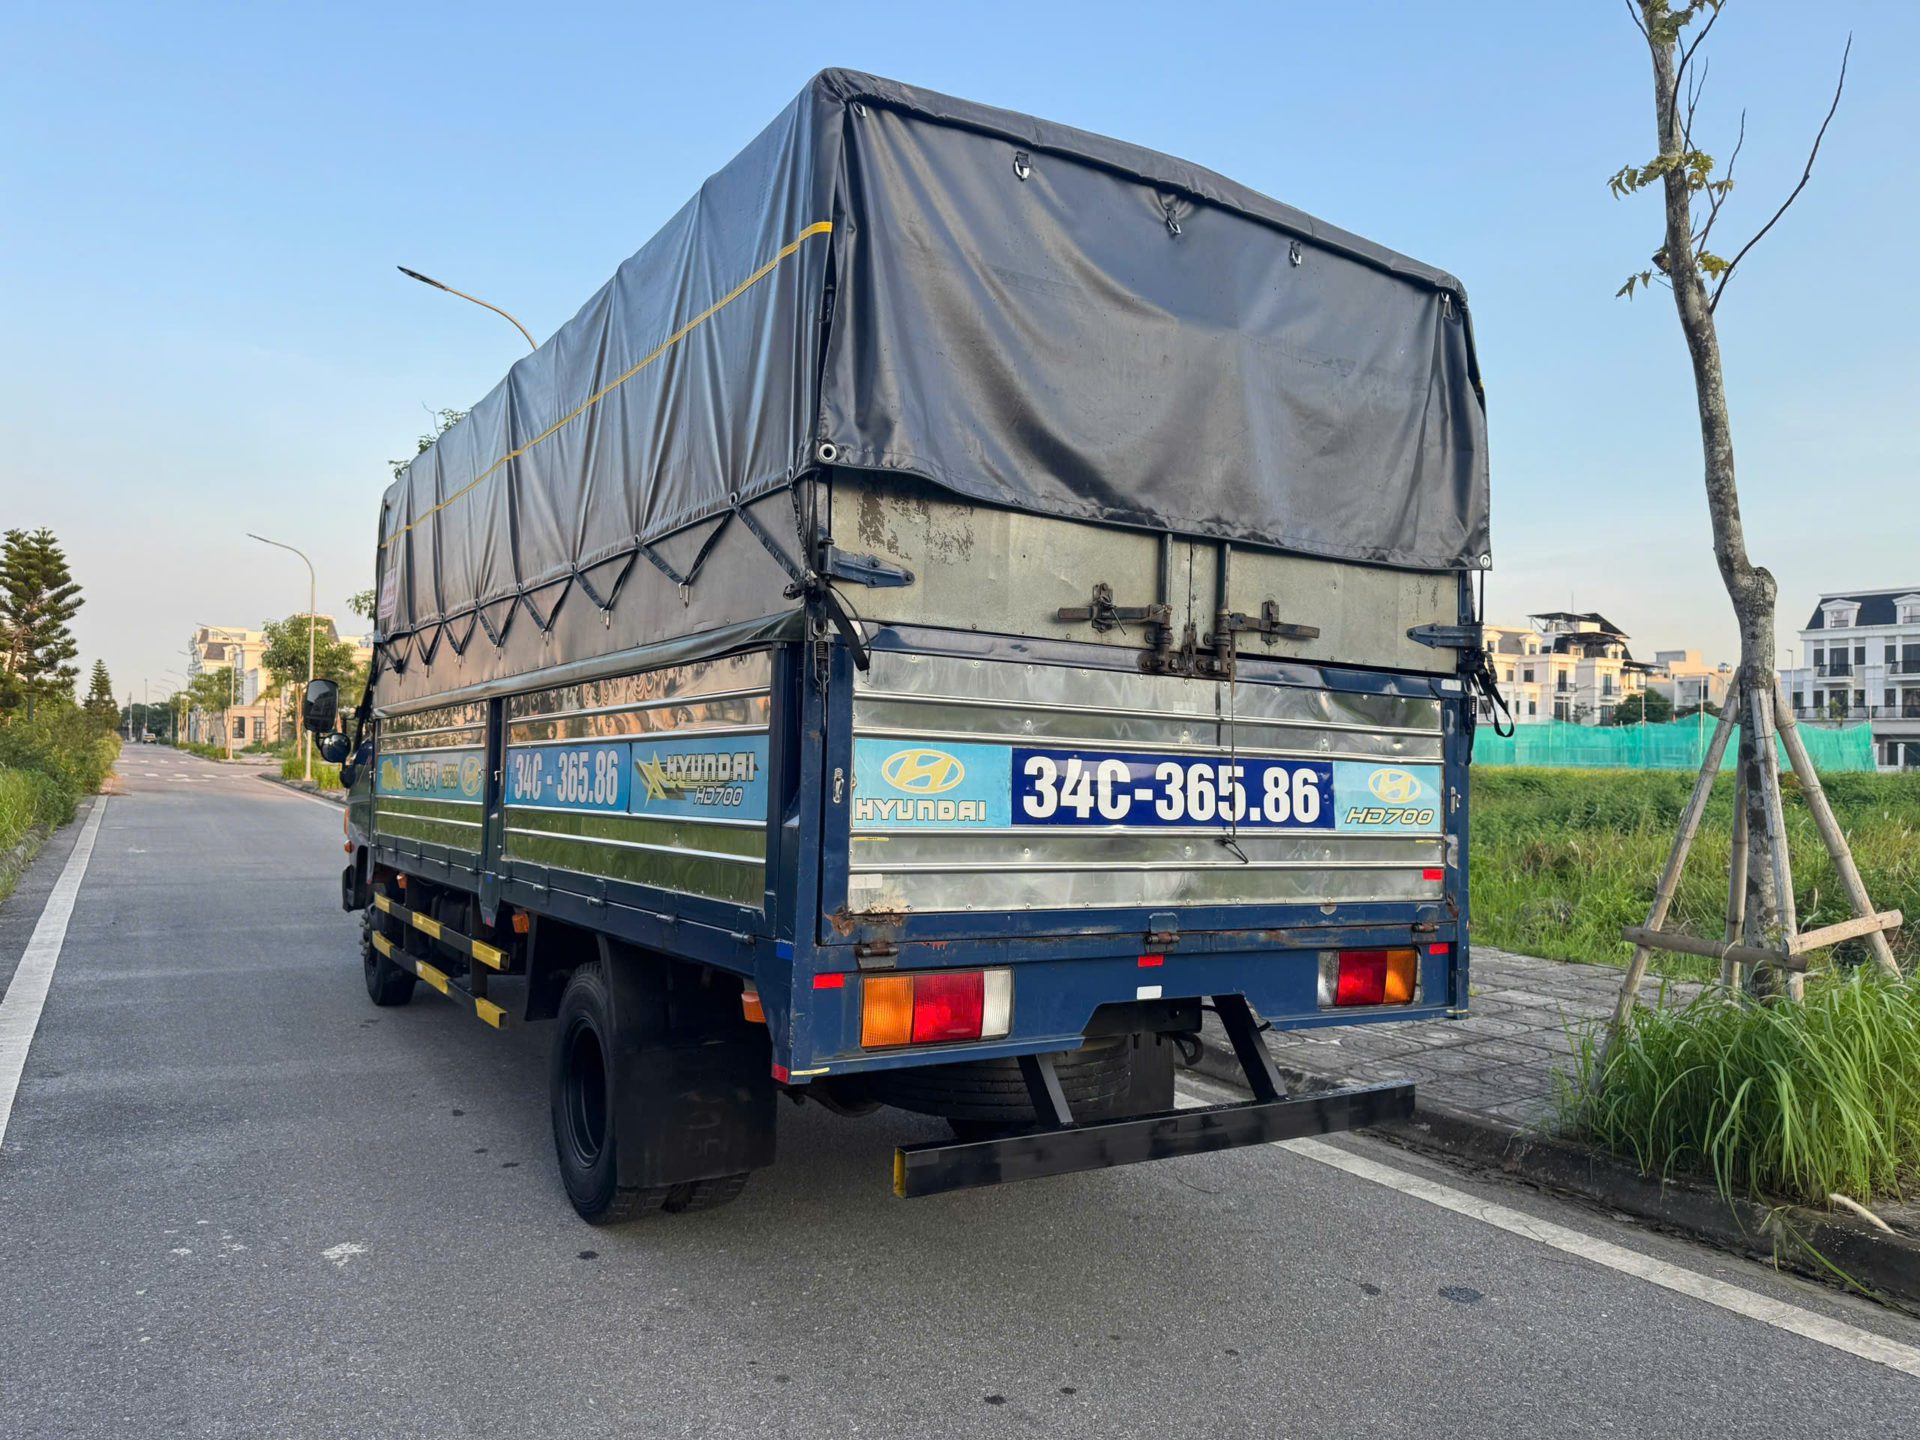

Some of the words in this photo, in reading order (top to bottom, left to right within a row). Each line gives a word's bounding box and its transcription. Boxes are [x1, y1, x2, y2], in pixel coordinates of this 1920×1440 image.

[514, 751, 542, 800] 34C
[557, 750, 619, 805] 365.86
[666, 752, 756, 782] HYUNDAI
[693, 786, 744, 806] HD700
[1023, 756, 1320, 823] 34C-365.86
[854, 798, 987, 822] HYUNDAI
[1345, 807, 1434, 825] HD700
